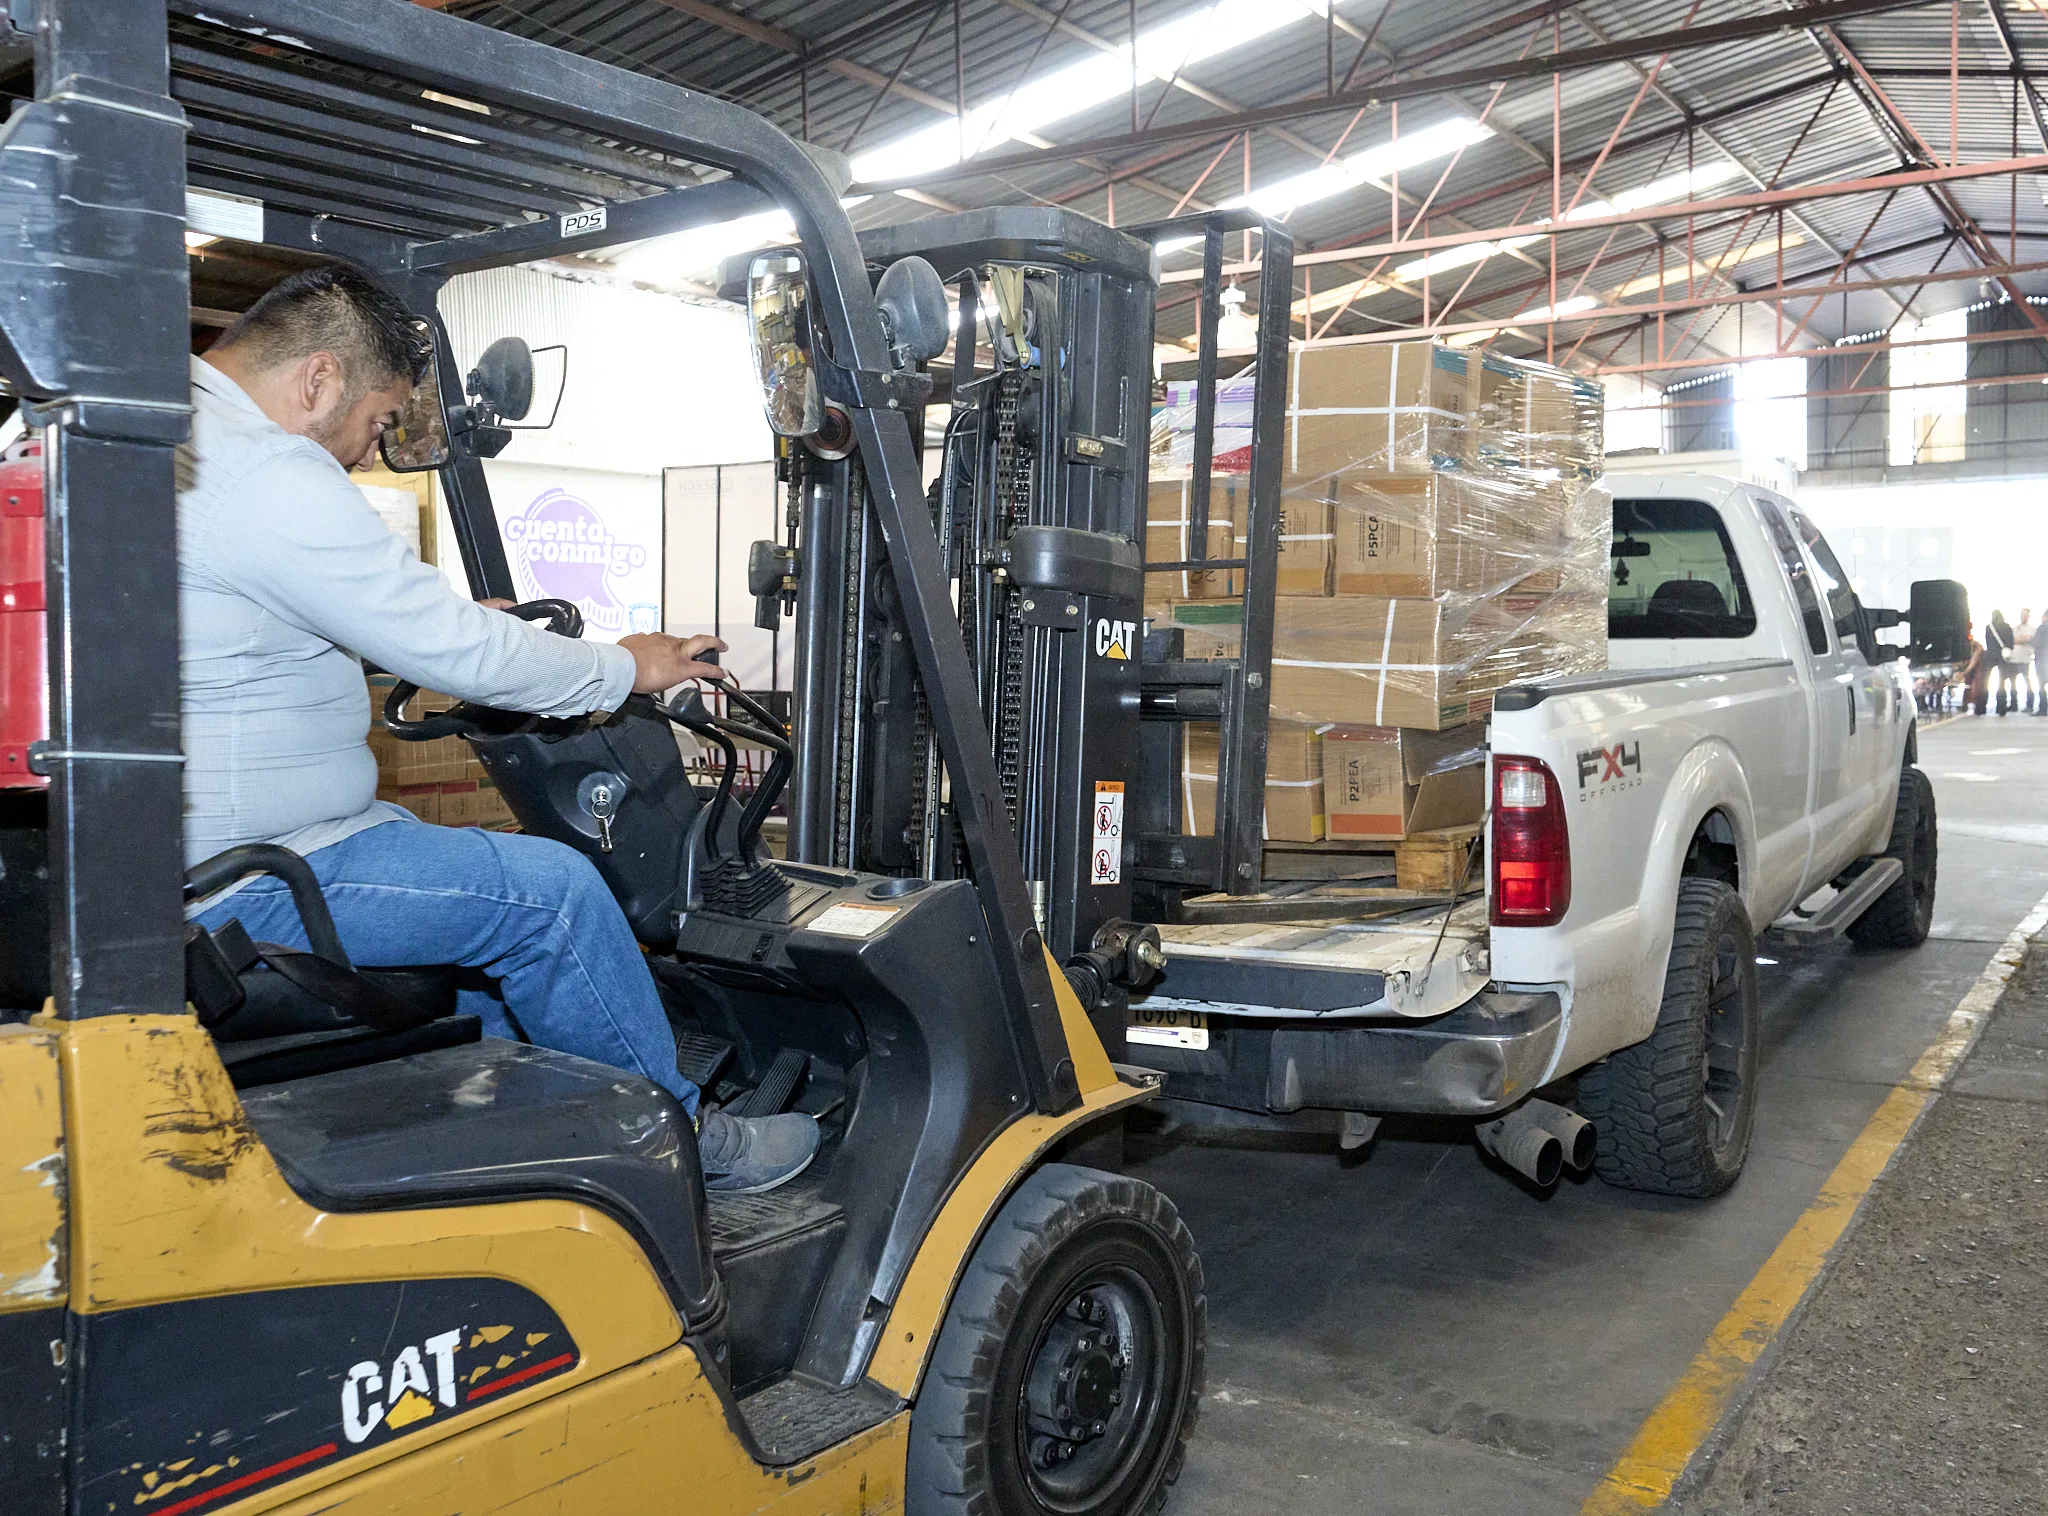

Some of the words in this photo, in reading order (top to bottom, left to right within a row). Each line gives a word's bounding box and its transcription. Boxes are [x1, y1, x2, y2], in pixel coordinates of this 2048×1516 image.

[565, 212, 602, 231] PDS
[526, 536, 646, 577] conmigo
[1096, 618, 1136, 660] CAT
[1348, 760, 1360, 802] P2PEA
[1576, 740, 1641, 788] FX4
[341, 1328, 461, 1443] CAT
